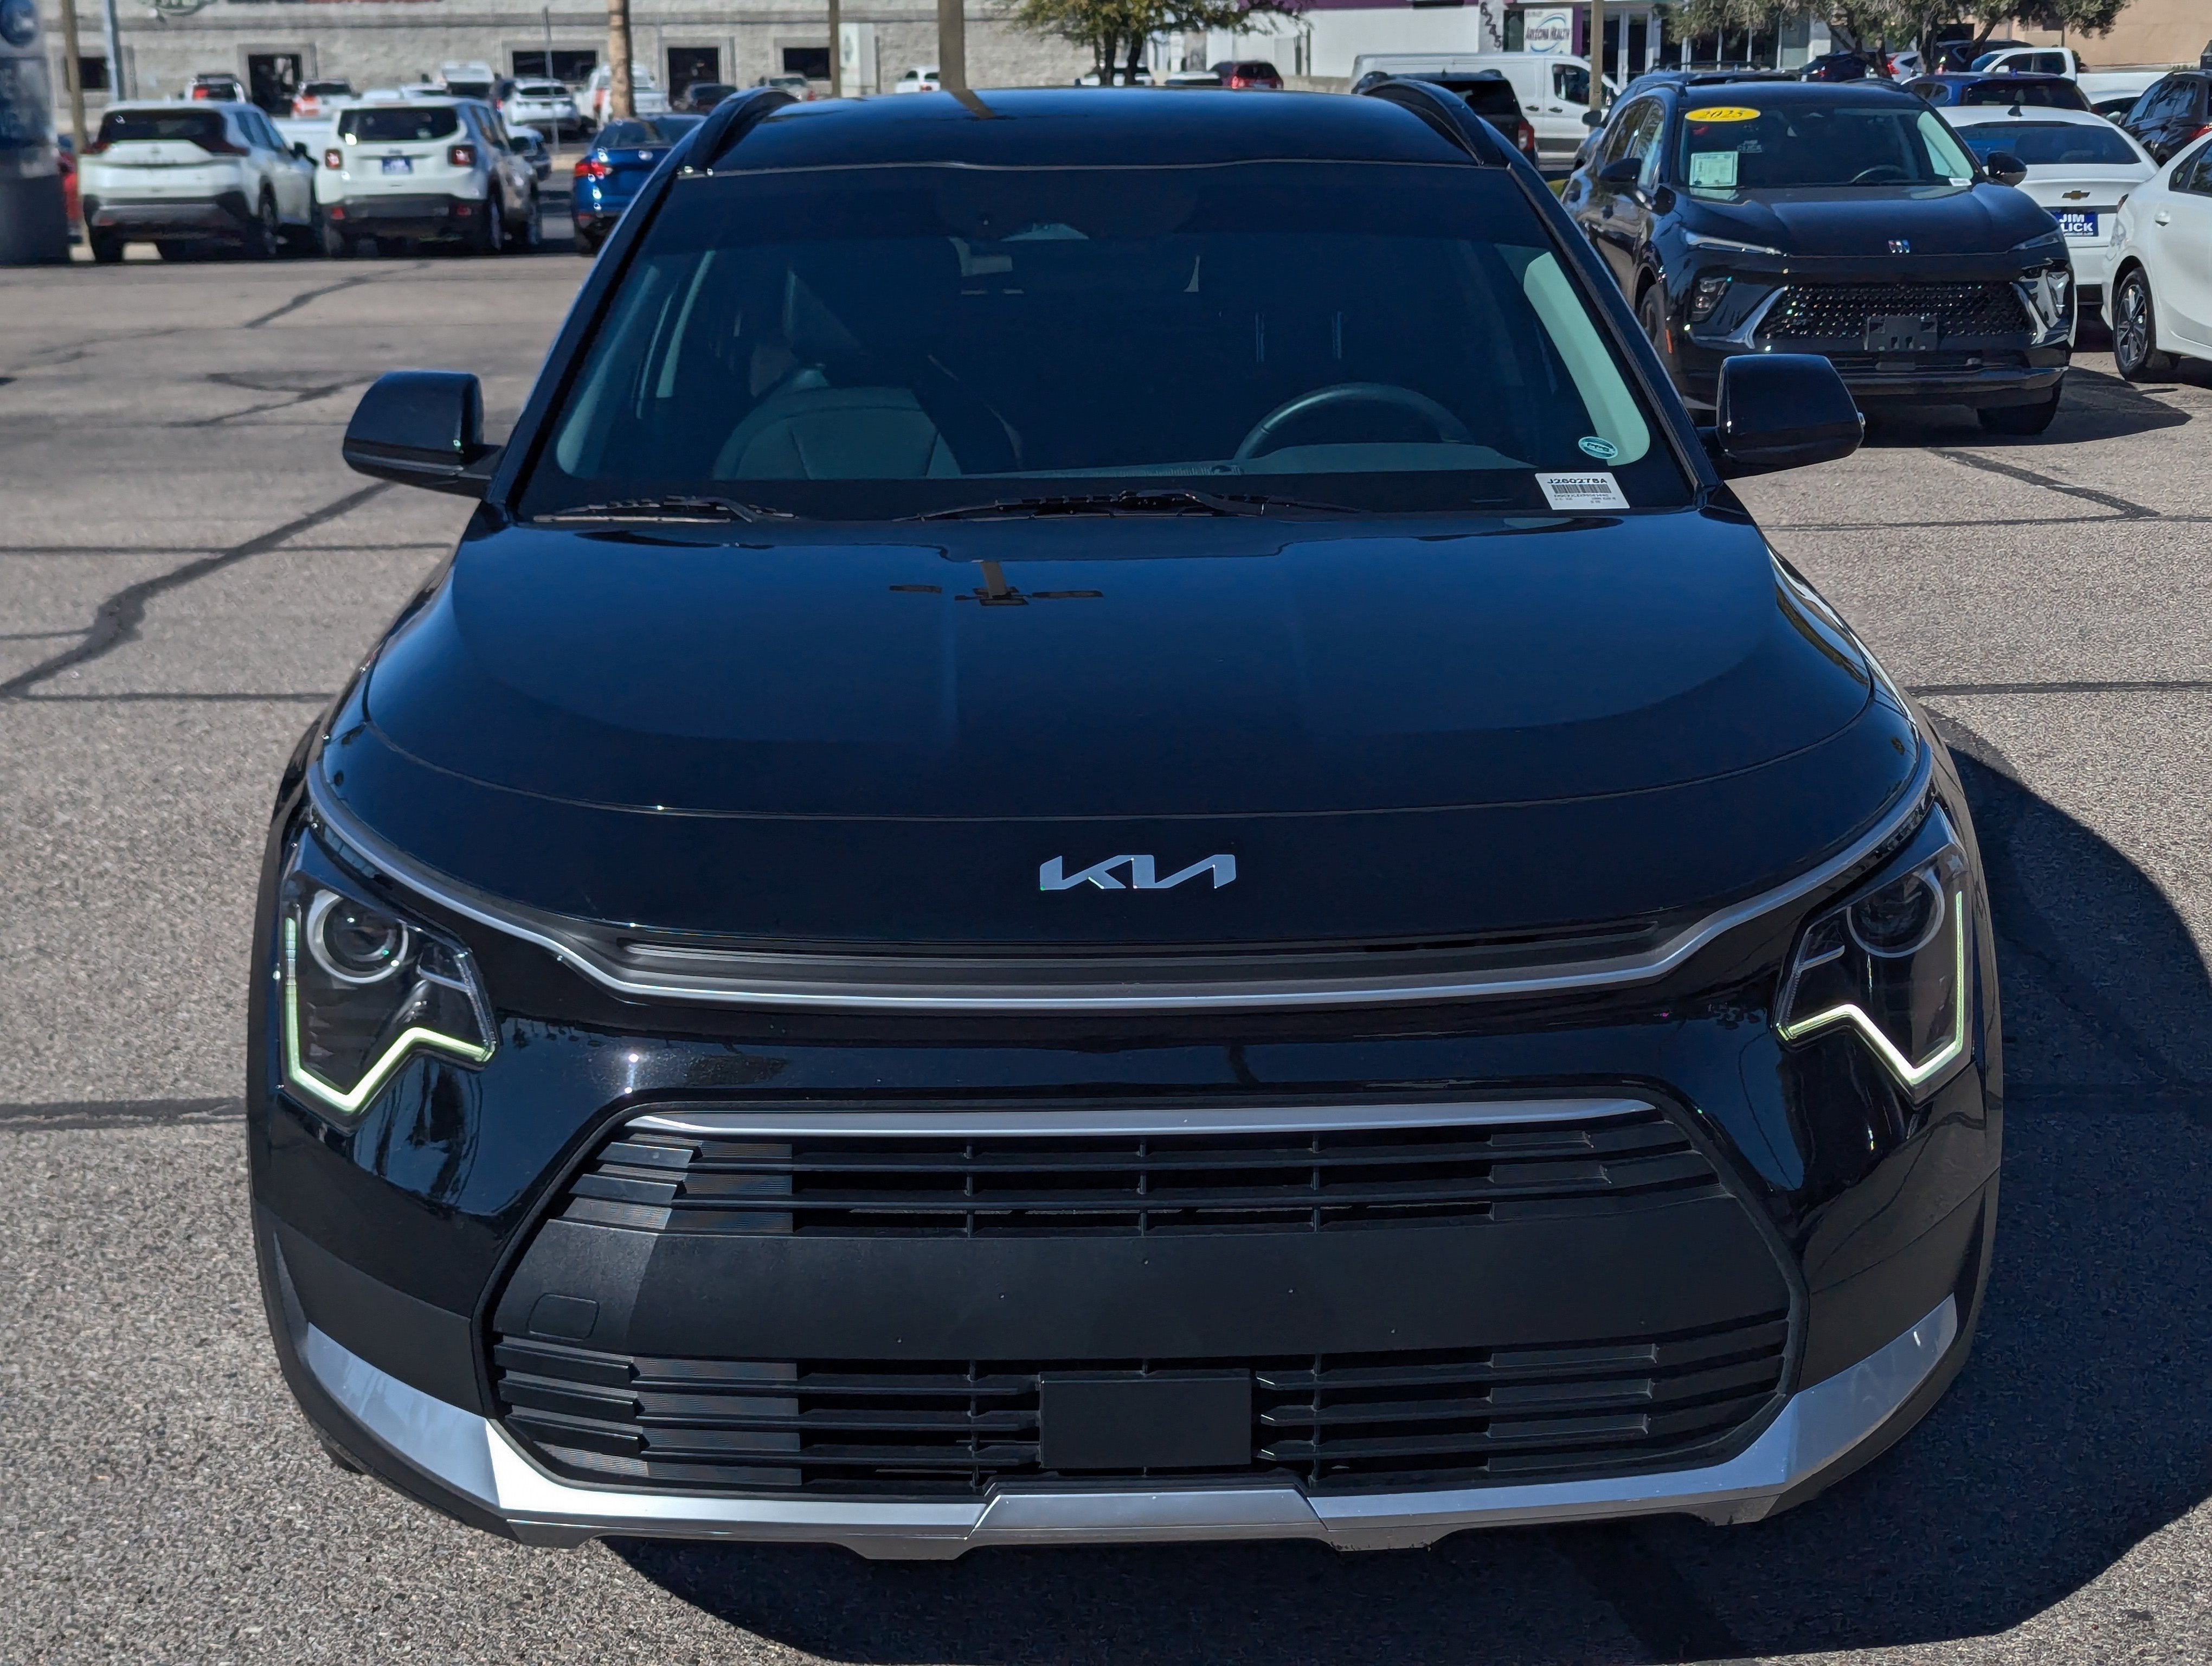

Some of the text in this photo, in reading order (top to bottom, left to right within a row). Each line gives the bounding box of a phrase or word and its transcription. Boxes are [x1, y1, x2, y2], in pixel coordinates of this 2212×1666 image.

[2059, 214, 2085, 222] JIM
[2060, 222, 2093, 232] LICK
[1039, 854, 1237, 890] KIA
